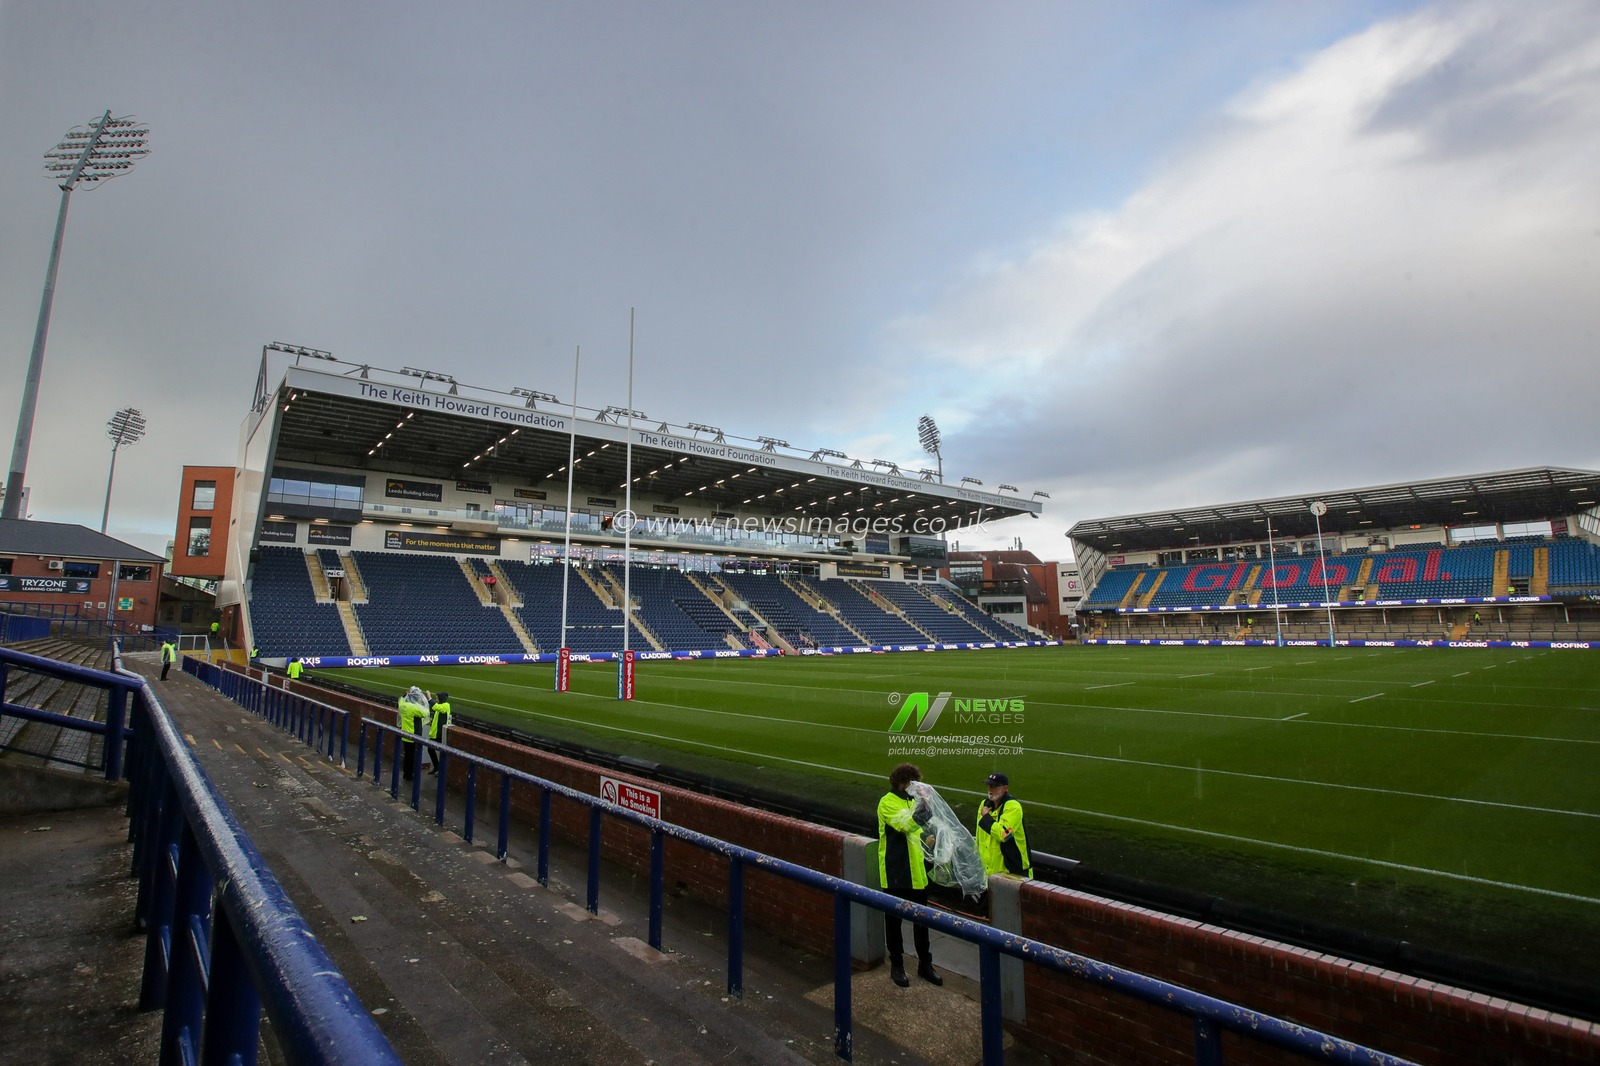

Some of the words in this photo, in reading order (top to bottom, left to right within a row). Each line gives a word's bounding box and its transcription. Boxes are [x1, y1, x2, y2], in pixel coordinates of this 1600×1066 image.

[359, 383, 388, 400] The
[392, 388, 430, 406] Keith
[435, 396, 490, 416] Howard
[494, 407, 565, 429] Foundation
[639, 432, 658, 445] The
[661, 436, 686, 450] Keith
[689, 442, 725, 457] Howard
[728, 449, 776, 465] Foundation
[826, 466, 839, 476] The
[841, 469, 859, 480] Keith
[861, 472, 886, 485] Howard
[888, 477, 921, 490] Foundation
[957, 490, 966, 498] The
[968, 492, 980, 501] Keith
[982, 494, 1000, 504] Howard
[1001, 498, 1026, 508] Foundation
[20, 578, 67, 587] TRYZONE
[299, 657, 320, 667] AXIS
[347, 658, 390, 666] ROOFING
[420, 655, 439, 664] AXIS
[523, 654, 540, 662] AXIS
[626, 788, 638, 799] This
[639, 792, 645, 801] is
[621, 797, 628, 806] No
[630, 800, 656, 817] Smoking
